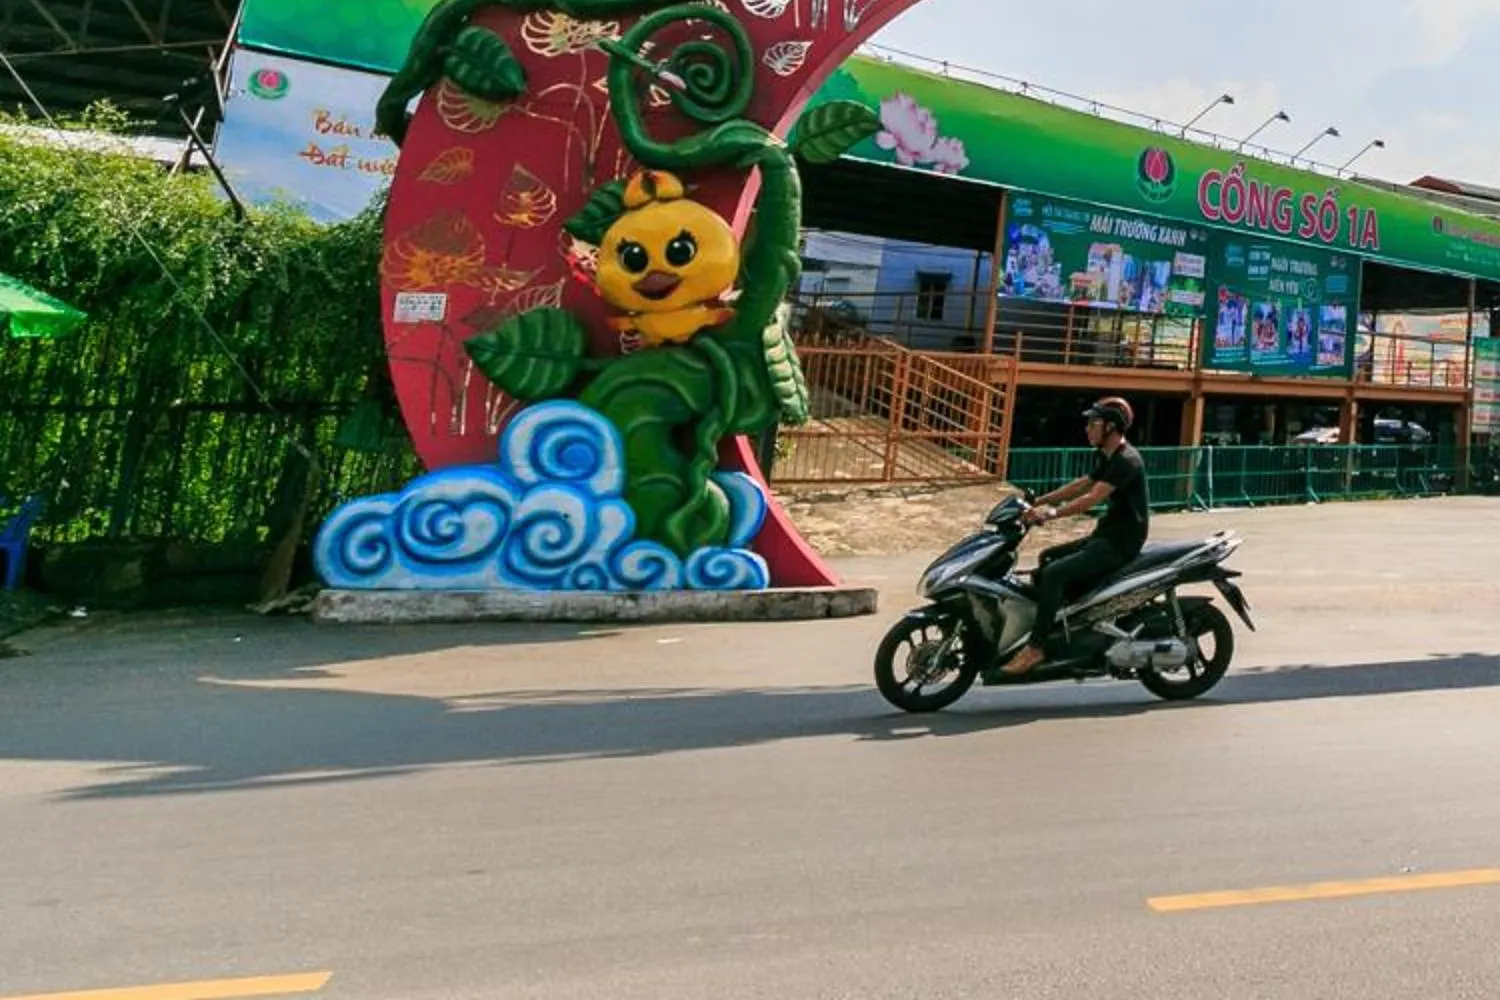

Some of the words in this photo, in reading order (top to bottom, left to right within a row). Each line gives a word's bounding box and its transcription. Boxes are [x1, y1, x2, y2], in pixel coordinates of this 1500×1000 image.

[1198, 161, 1294, 234] CỔNG
[1298, 186, 1340, 243] SỐ
[1348, 204, 1380, 250] 1A
